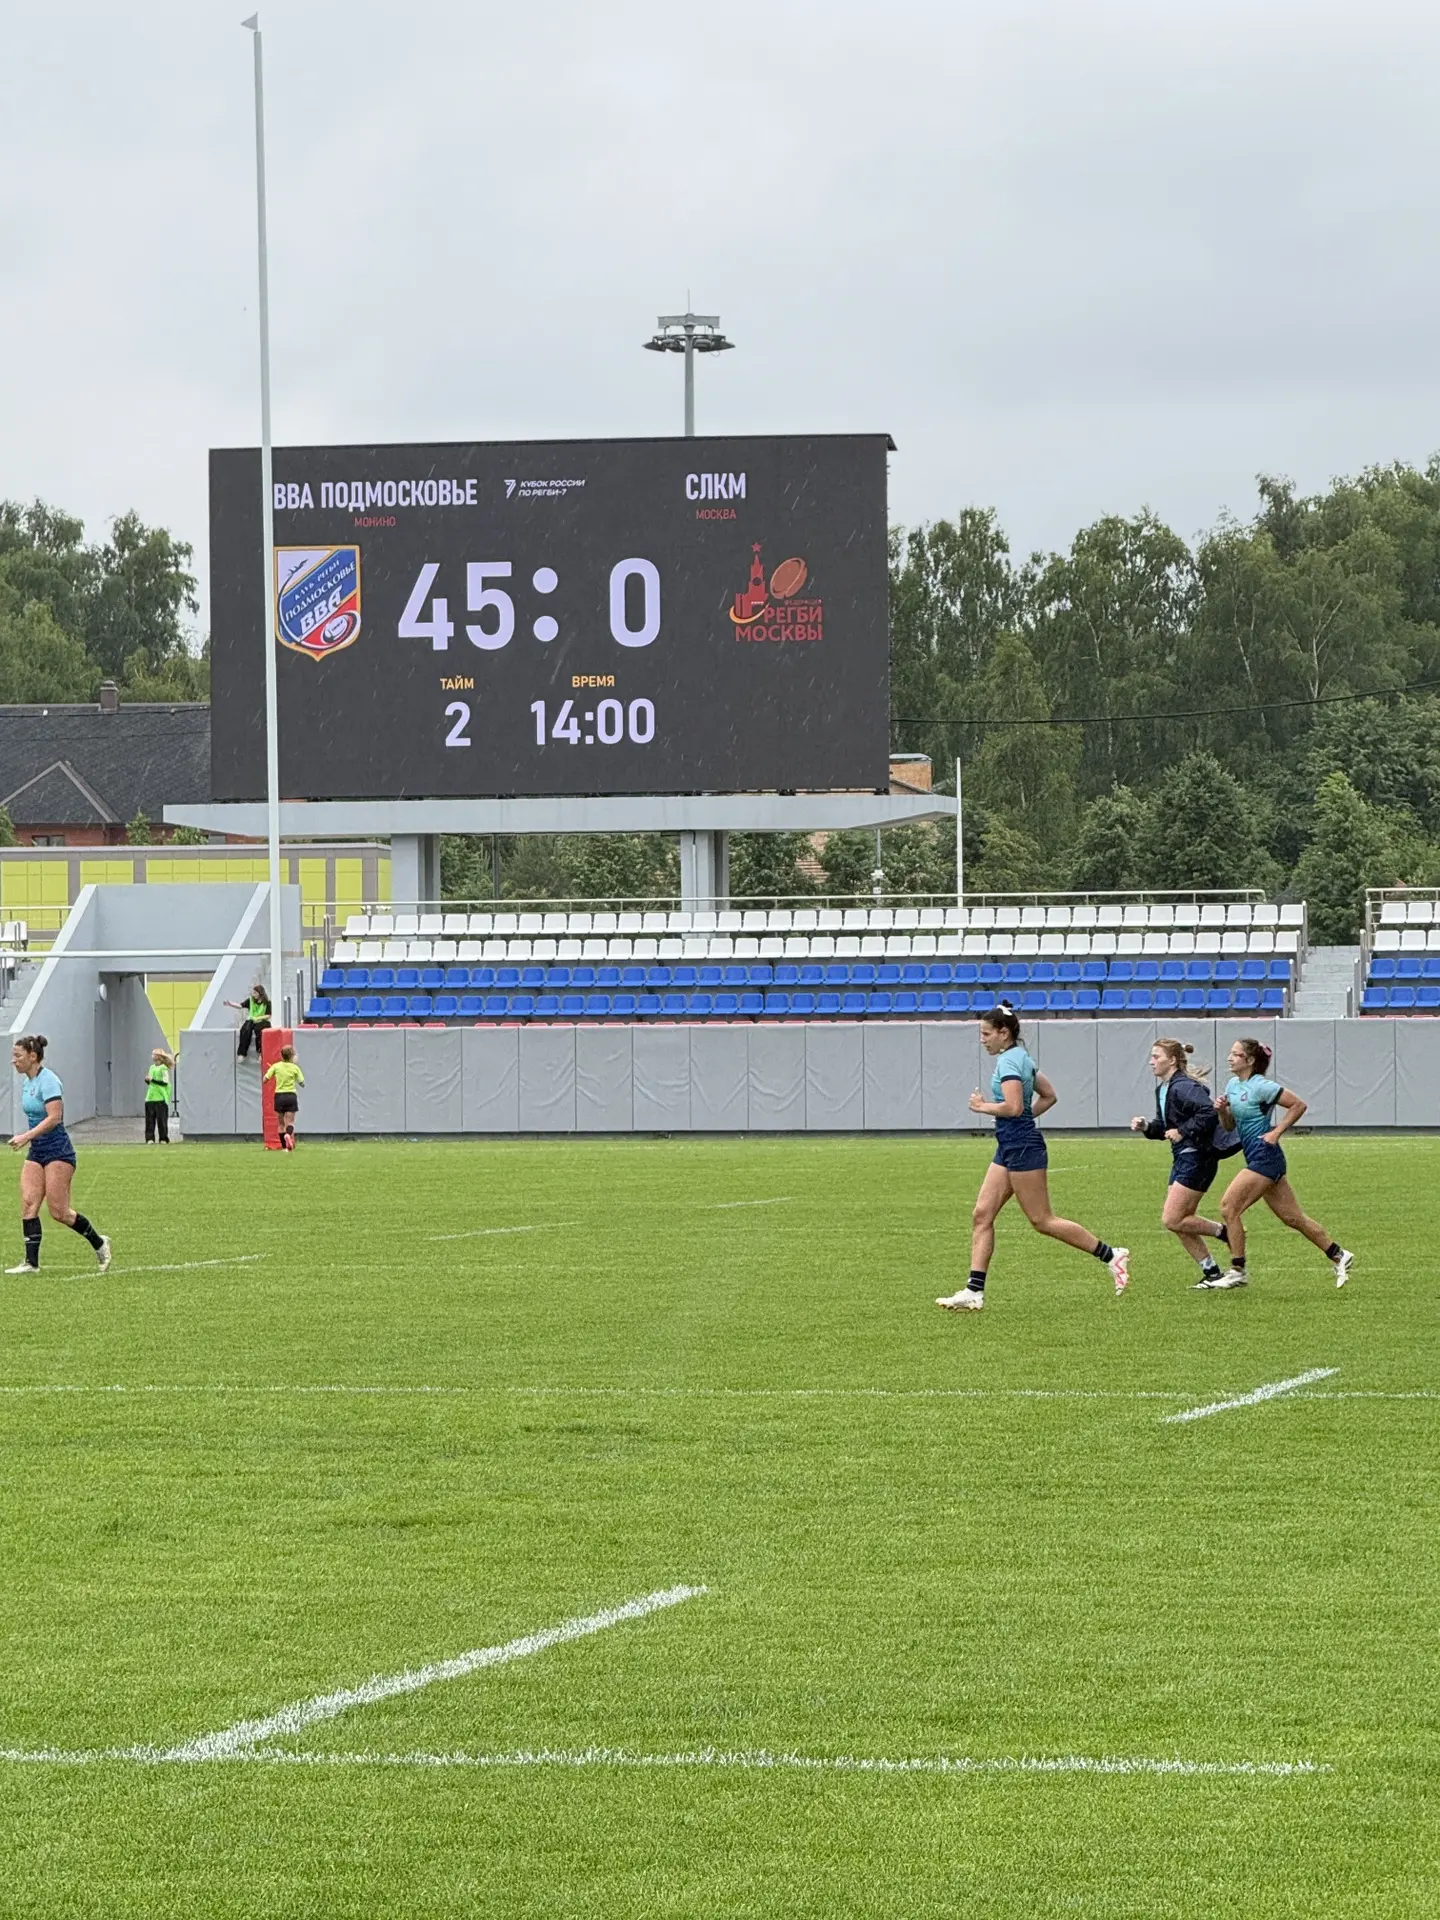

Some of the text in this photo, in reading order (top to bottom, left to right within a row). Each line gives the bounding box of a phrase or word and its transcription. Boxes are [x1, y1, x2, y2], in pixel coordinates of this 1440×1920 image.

[532, 488, 567, 496] РЕГБИ-7
[549, 479, 585, 487] РОССИИ
[685, 472, 746, 500] СЛКМ
[273, 479, 478, 512] ВВА ПОДМОСКОВЬЕ
[354, 516, 396, 527] МОНИНО
[696, 508, 736, 520] МОСКВА
[285, 561, 356, 621] ПОДМОСКОВЬЕ
[300, 584, 343, 636] ВВА
[609, 557, 661, 648] 0
[763, 606, 823, 624] РЕГБИ
[735, 623, 823, 642] МОСКВЫ
[439, 675, 474, 690] ТАЙМ
[572, 675, 615, 687] ВРЕМЯ
[444, 701, 472, 747] 2
[530, 697, 656, 746] 14:00
